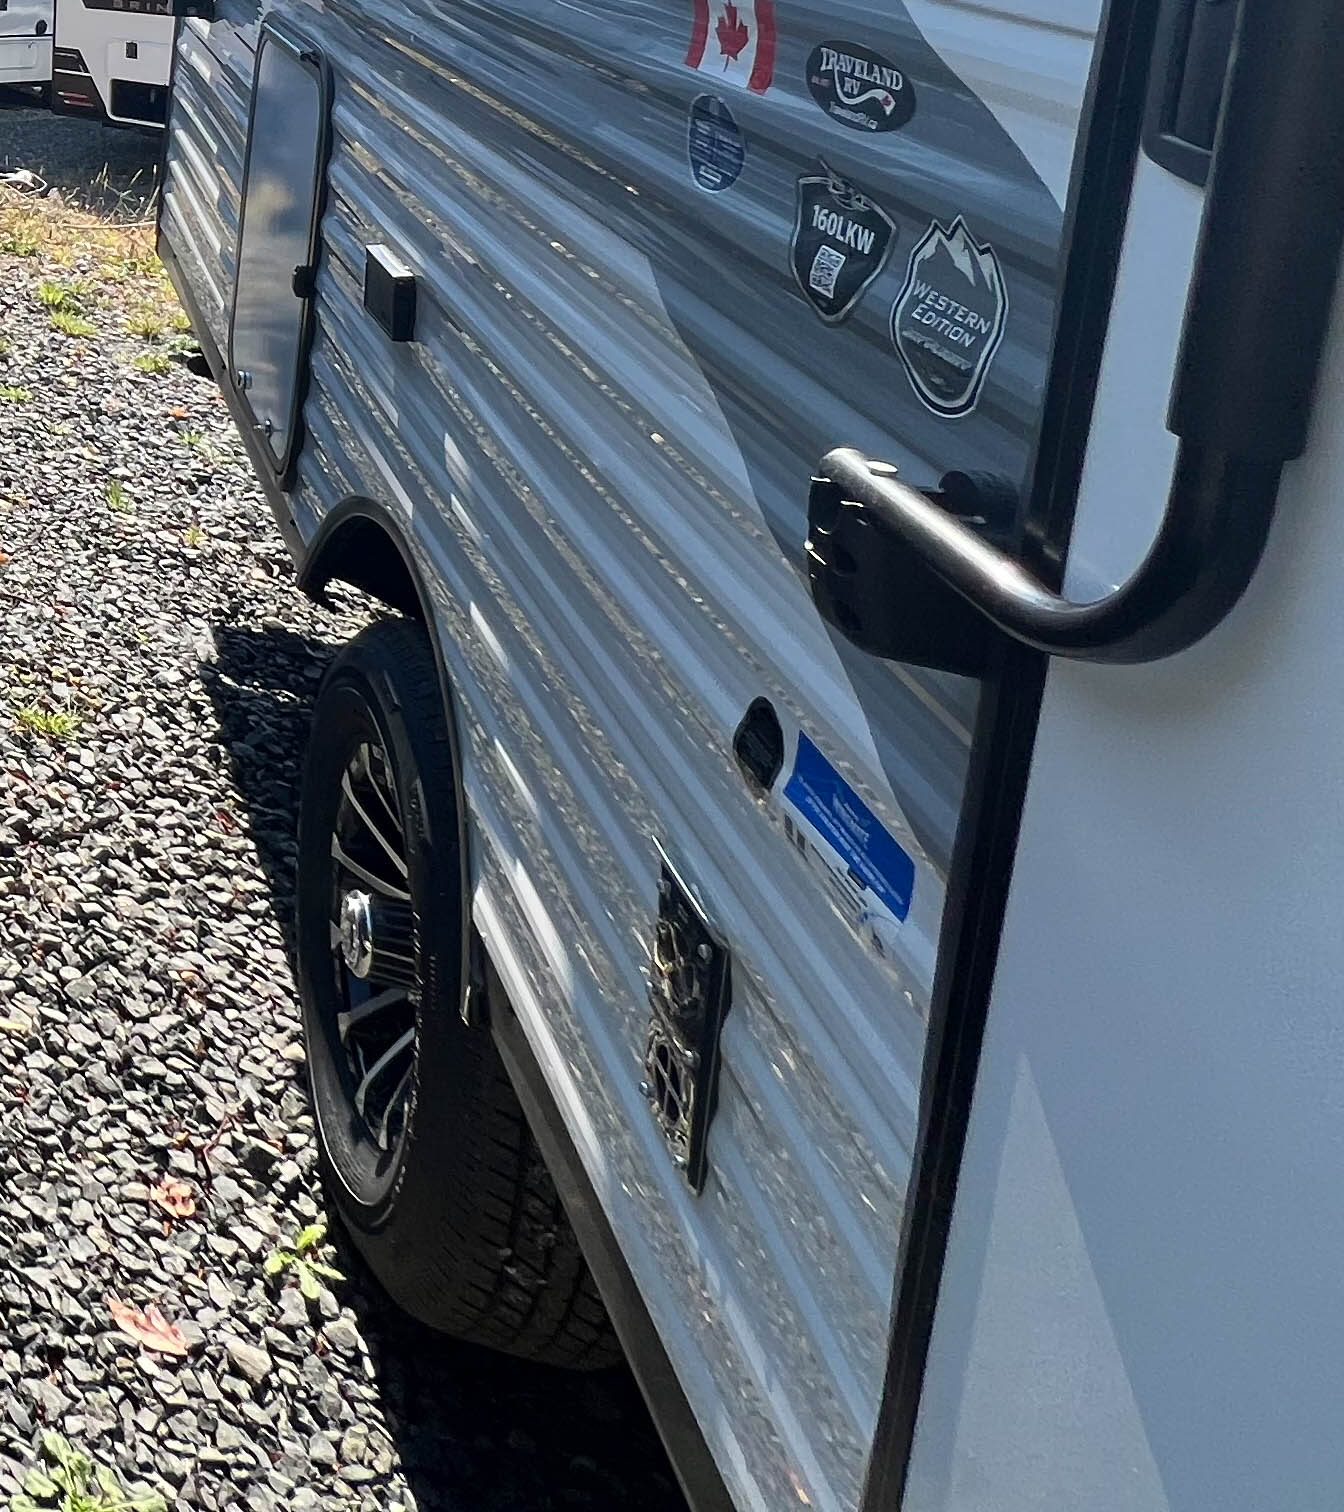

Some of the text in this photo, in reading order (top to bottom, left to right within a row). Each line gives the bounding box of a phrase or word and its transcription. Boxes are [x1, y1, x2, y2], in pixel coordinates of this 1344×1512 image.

[820, 47, 903, 91] TRAVELAND
[843, 77, 861, 96] RV
[812, 204, 875, 255] 160LKW
[911, 303, 976, 348] EDITION
[913, 280, 991, 334] WESTERN
